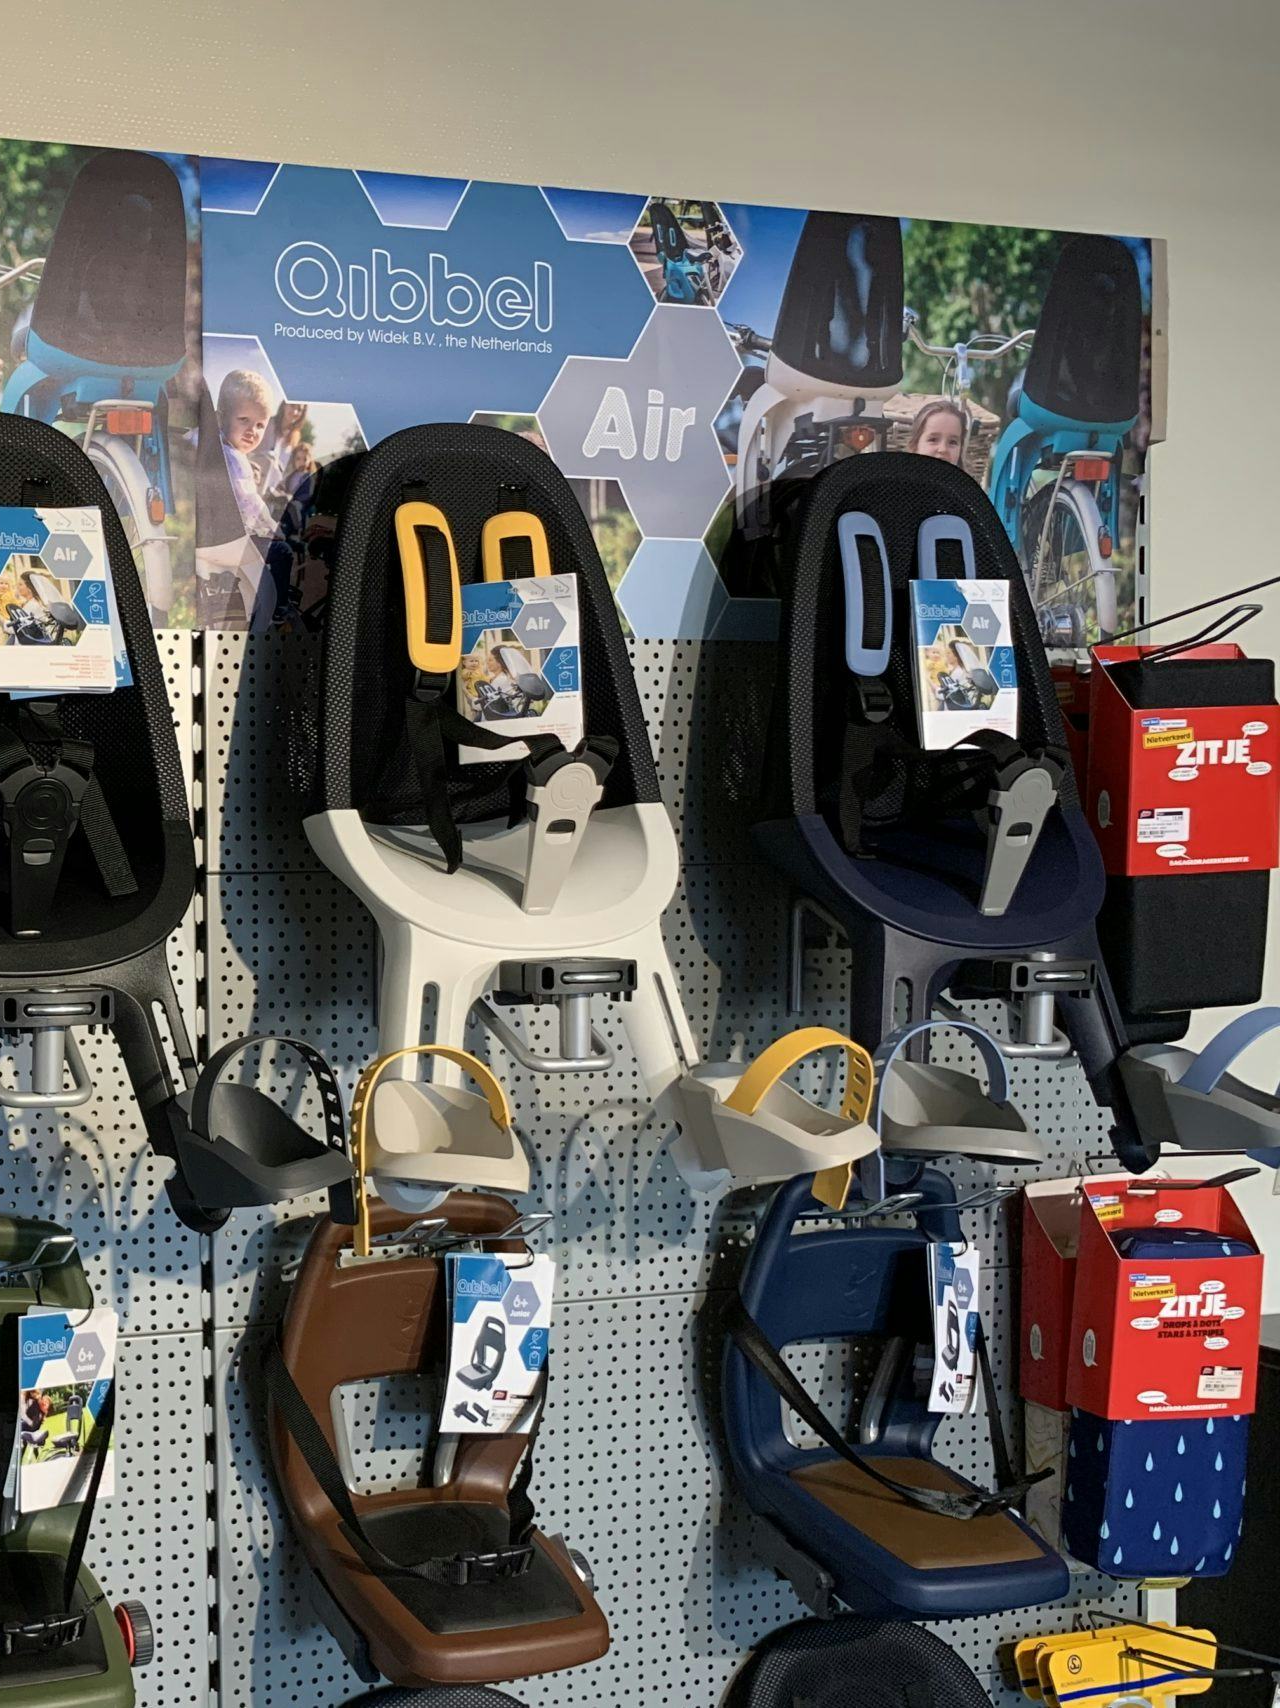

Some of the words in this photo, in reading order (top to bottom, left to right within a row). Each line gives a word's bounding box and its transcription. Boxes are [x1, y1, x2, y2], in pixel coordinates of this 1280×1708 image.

[275, 241, 552, 333] Qibbel
[274, 323, 343, 341] Produced
[347, 328, 364, 345] by
[367, 328, 409, 345] Widek
[445, 333, 467, 348] the
[471, 335, 552, 354] Netherlands
[582, 386, 696, 462] Air
[53, 547, 78, 562] Air
[525, 616, 550, 632] Air
[972, 616, 990, 629] Air
[1176, 739, 1251, 766] ZITJE
[512, 1295, 528, 1308] 6+
[1159, 1293, 1227, 1318] ZITJE
[510, 1310, 531, 1318] Junior
[1163, 1320, 1192, 1329] DROPS
[1200, 1319, 1221, 1327] DOTS
[1157, 1330, 1184, 1338] STARS
[1193, 1328, 1225, 1337] STRIPES
[78, 1347, 94, 1362] 6+
[76, 1363, 97, 1373] Junior
